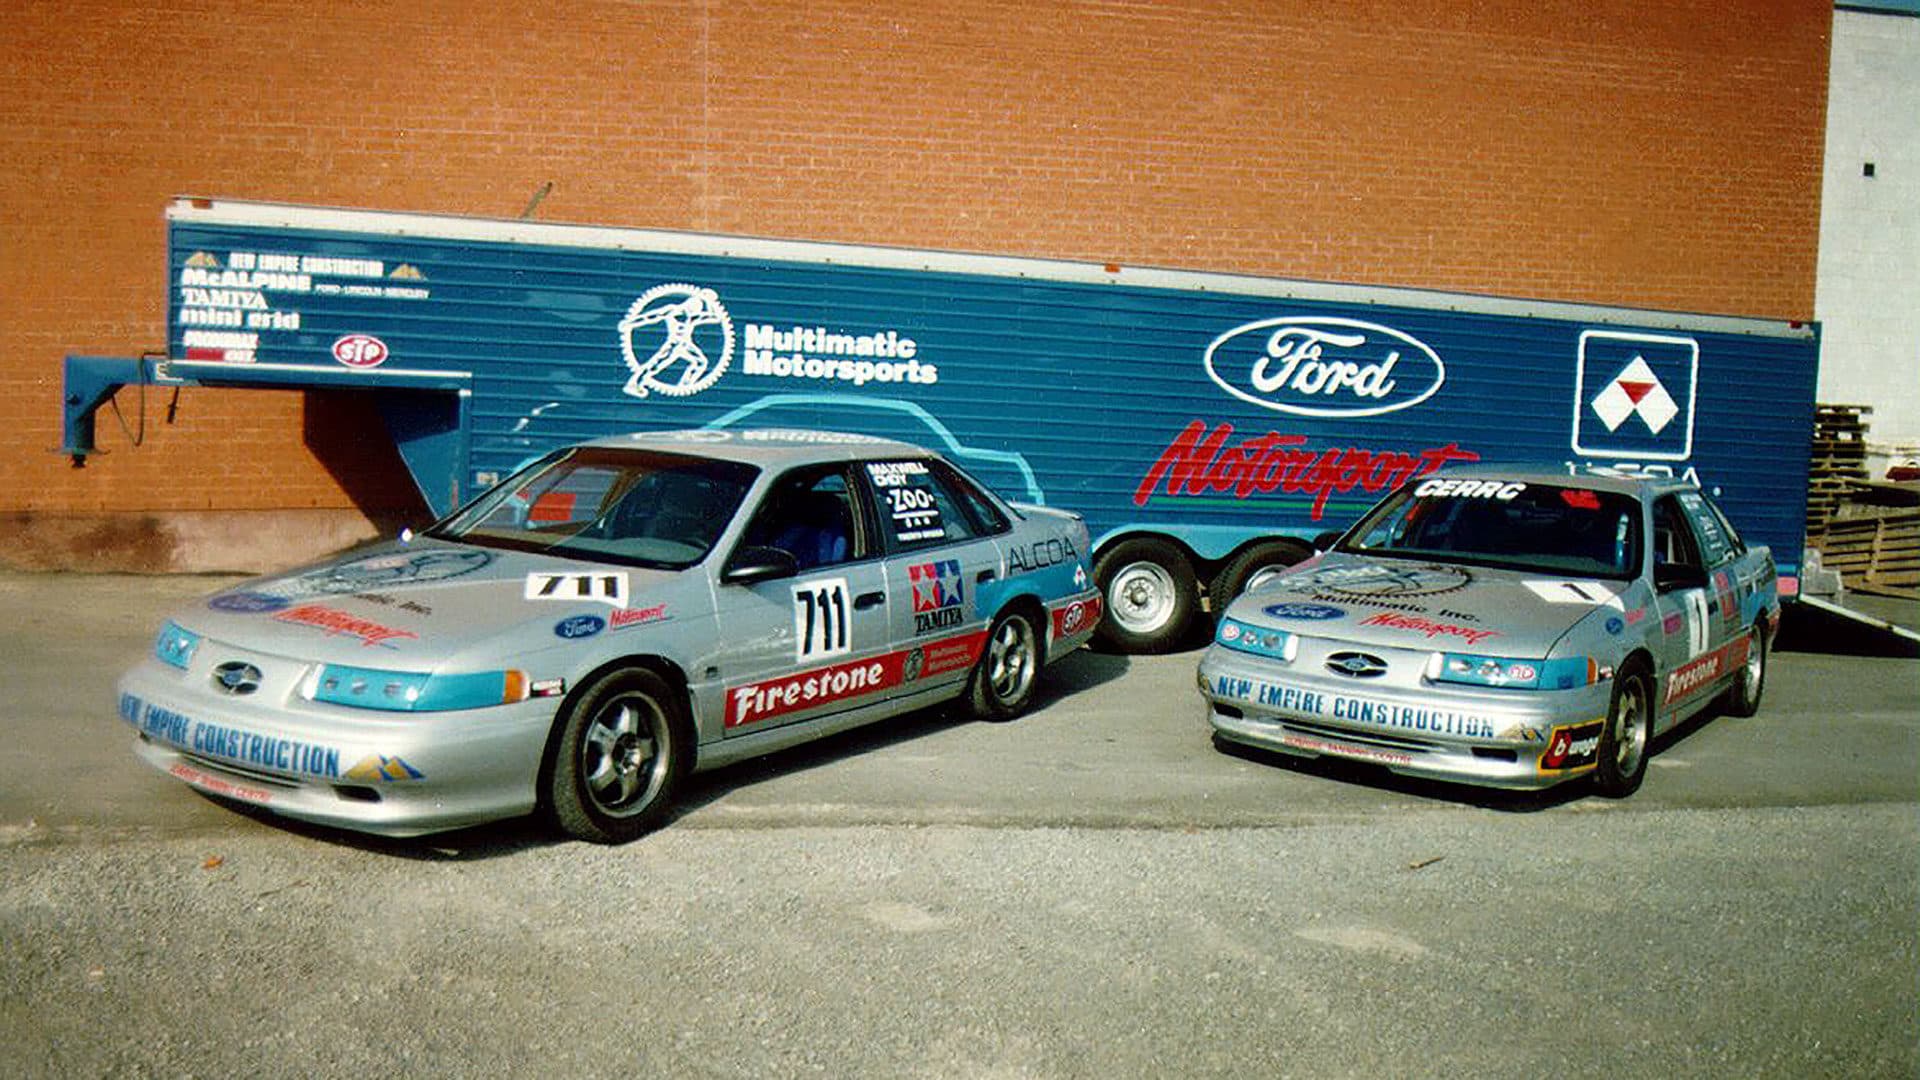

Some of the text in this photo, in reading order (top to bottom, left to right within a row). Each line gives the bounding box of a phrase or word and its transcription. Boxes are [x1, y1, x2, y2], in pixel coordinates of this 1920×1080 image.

[181, 268, 311, 292] McALPINE
[229, 252, 384, 278] NEW EMPIRE CONSTRUCTION
[181, 288, 269, 309] TAMIYA
[340, 339, 380, 362] STP
[744, 324, 917, 358] Multimatic
[743, 350, 938, 385] Motorsports
[1251, 326, 1400, 398] Ford
[1133, 419, 1480, 521] Motorsport
[1008, 537, 1078, 577] ALCOA
[537, 575, 618, 598] 711
[564, 604, 667, 637] Ford Motorsport
[797, 586, 846, 655] 711
[914, 608, 963, 636] TAMIYA
[1312, 594, 1482, 623] Multimatic Inc.
[1359, 612, 1503, 645] Motorsport
[734, 662, 884, 724] Firestone
[1665, 655, 1719, 706] Firestone
[1218, 676, 1494, 738] NEW EMPIRE CONSTRUCTION
[194, 720, 341, 779] CONSTRUCTION
